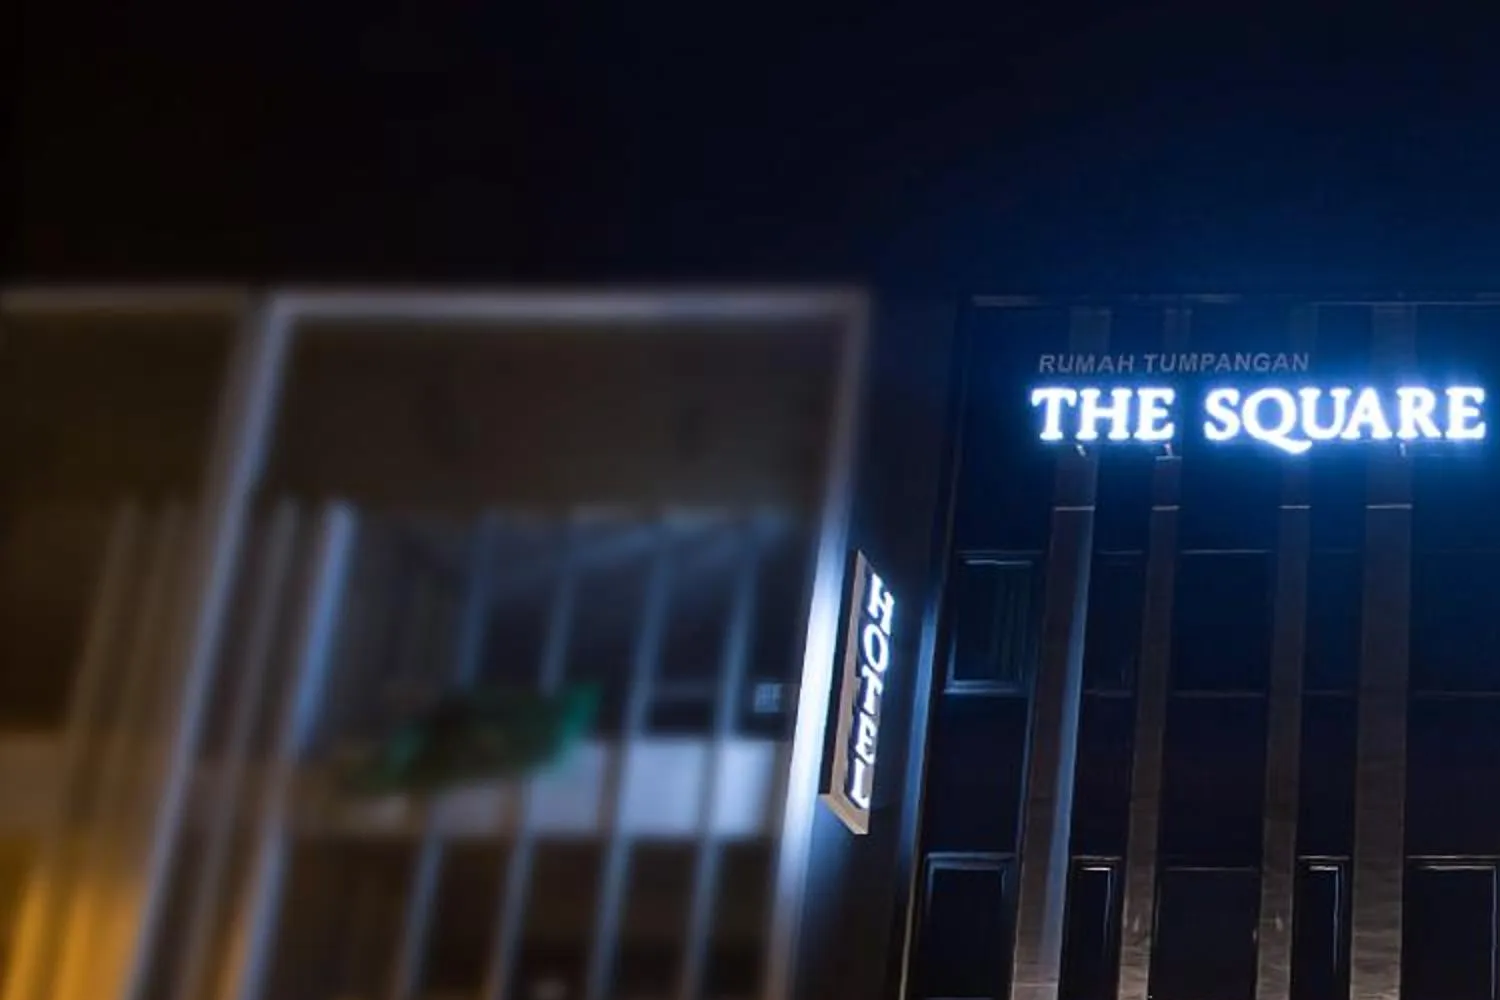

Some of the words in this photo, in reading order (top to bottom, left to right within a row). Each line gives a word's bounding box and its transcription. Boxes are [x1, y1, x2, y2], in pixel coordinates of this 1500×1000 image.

[1038, 353, 1135, 374] RUMAH
[1143, 351, 1310, 374] TUMPANGAN
[1030, 386, 1176, 442] THE
[1203, 386, 1487, 455] SQUARE
[850, 571, 894, 810] HOTEL
